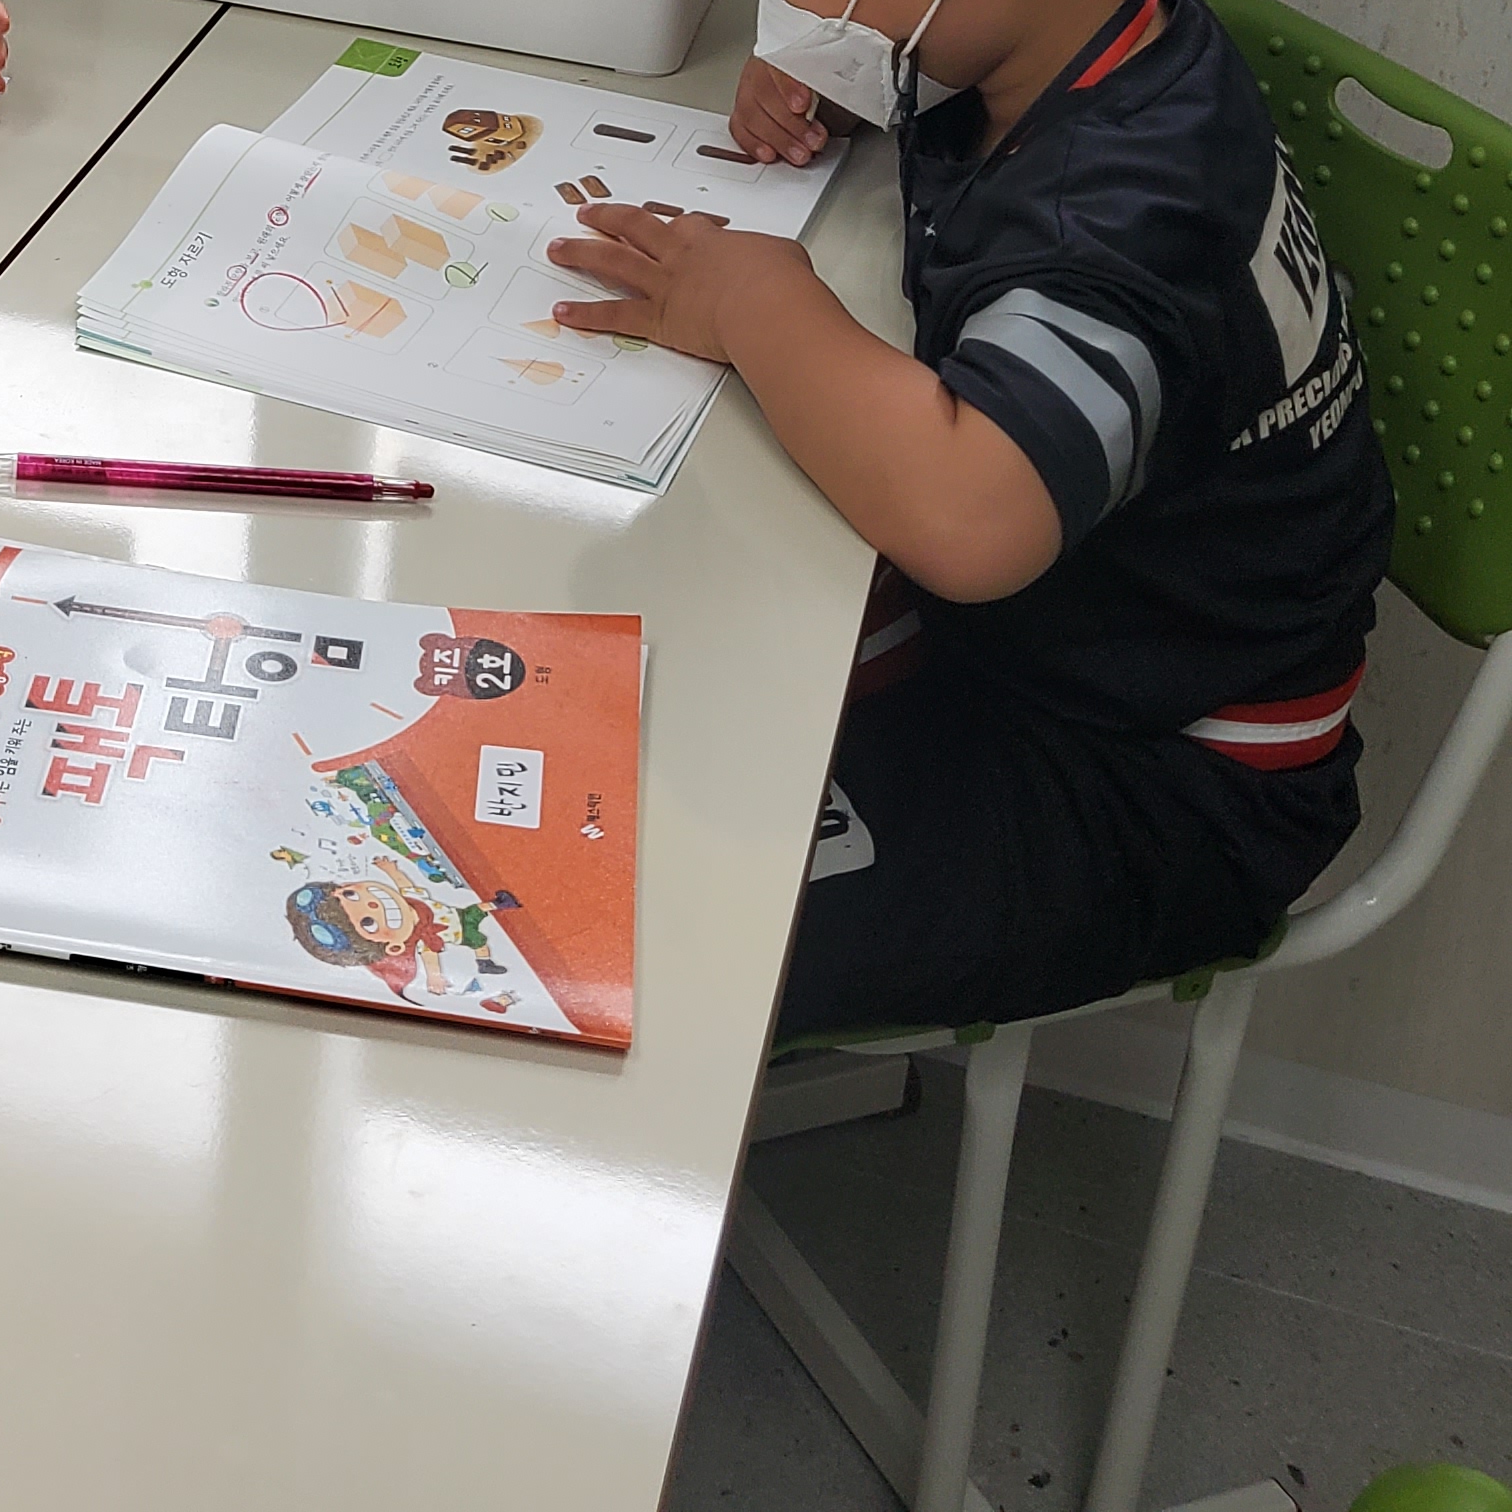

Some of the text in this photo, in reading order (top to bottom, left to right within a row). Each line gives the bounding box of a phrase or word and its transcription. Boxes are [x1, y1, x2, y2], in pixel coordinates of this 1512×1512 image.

[161, 231, 213, 288] 도형 자르기
[433, 648, 512, 690] 키즈 2호
[535, 665, 552, 685] 도형
[5, 738, 24, 754] 키워
[12, 719, 32, 735] 주는
[25, 674, 185, 805] 팩토
[487, 762, 528, 817] 반지민
